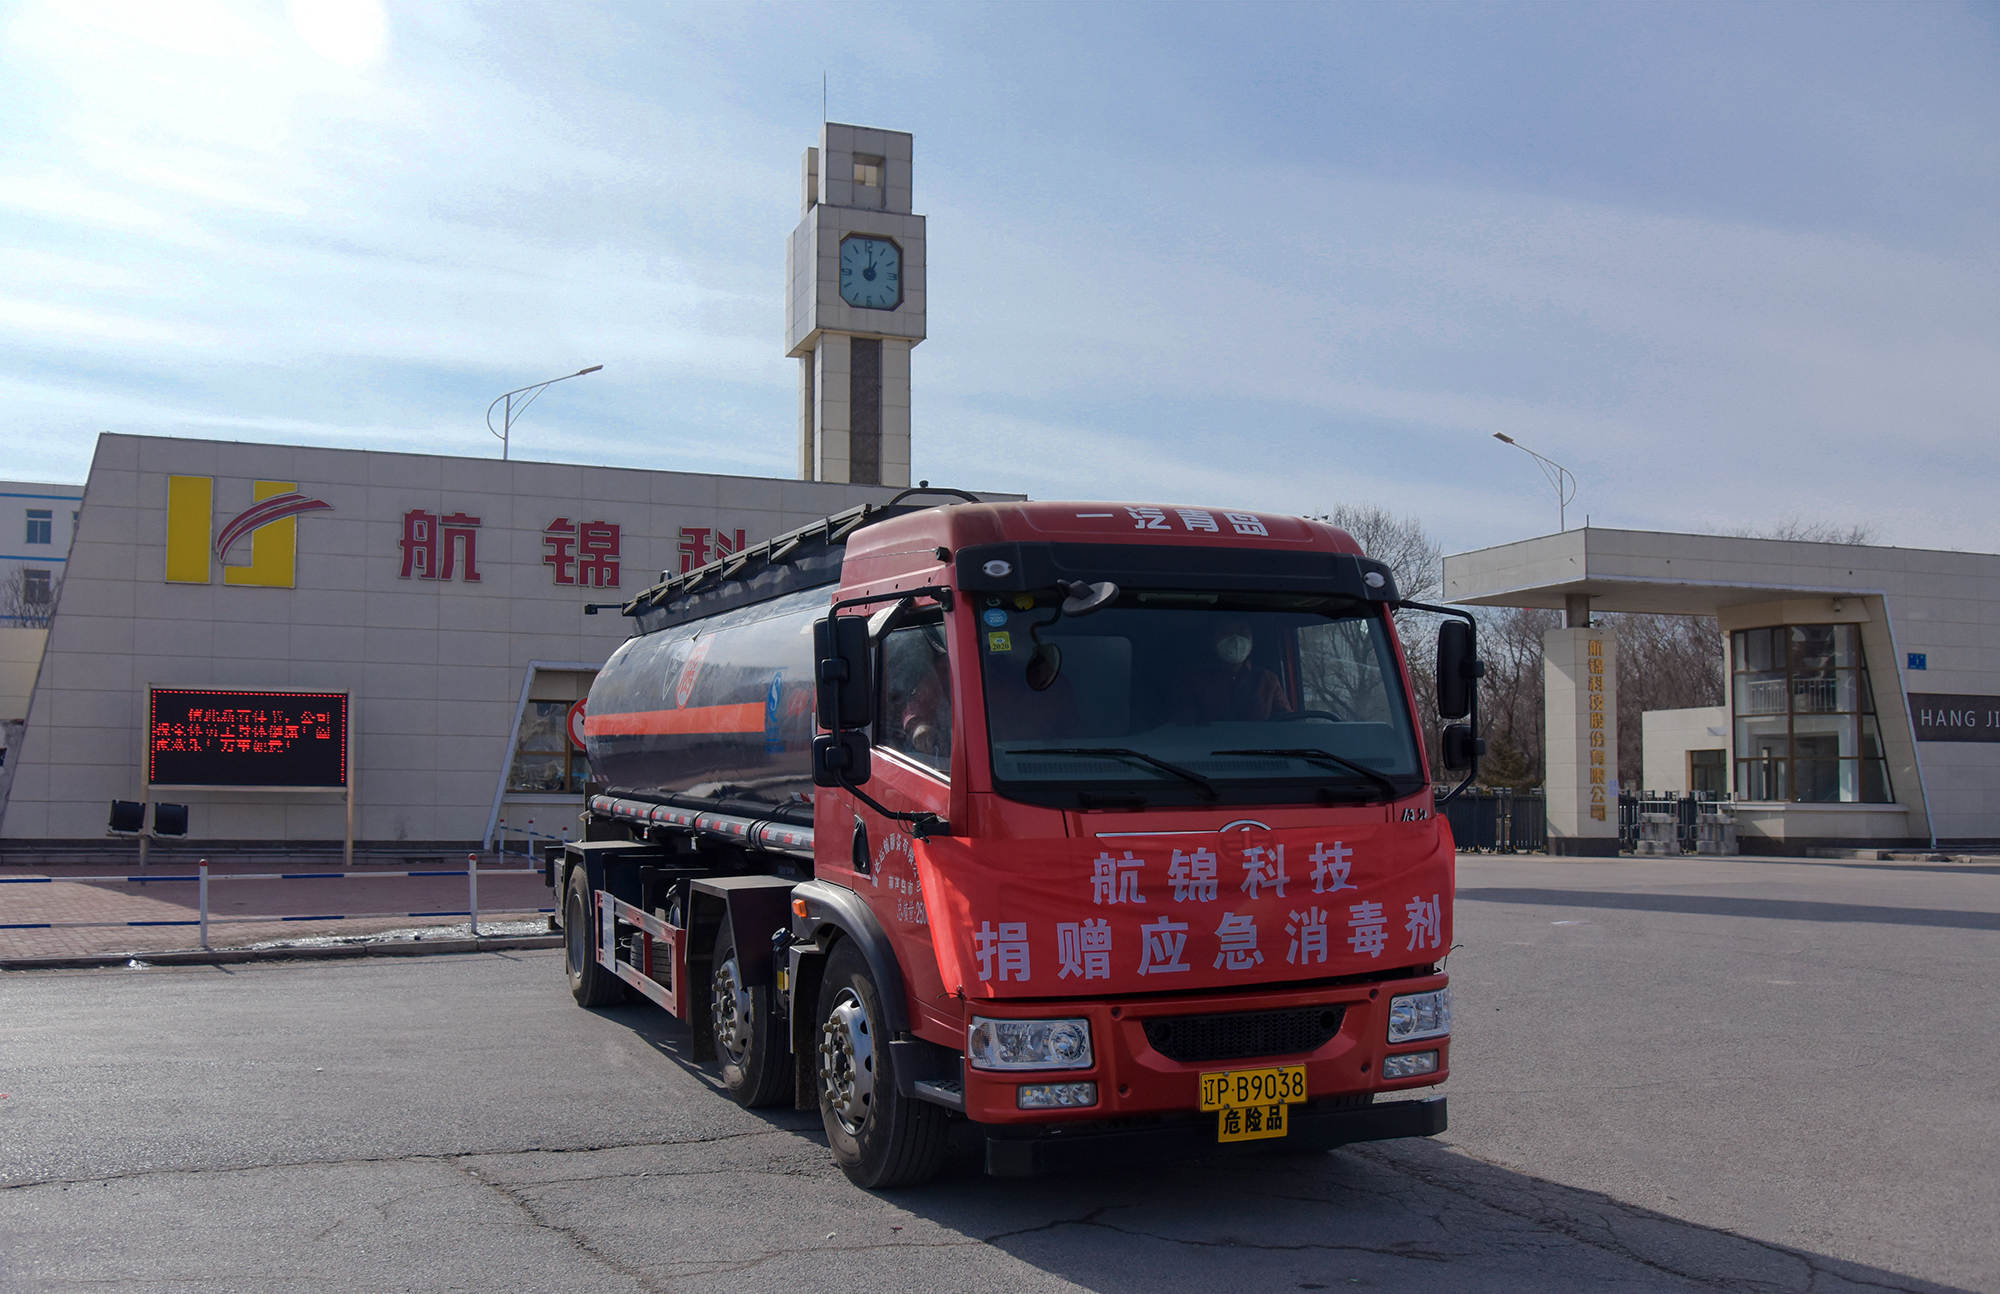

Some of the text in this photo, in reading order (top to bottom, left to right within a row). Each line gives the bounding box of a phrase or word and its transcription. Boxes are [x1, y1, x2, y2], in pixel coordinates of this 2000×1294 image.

[1076, 506, 1269, 536] 一汽青岛
[1588, 639, 1607, 822] 航锦科技股份有限公司
[1920, 708, 1976, 727] HANG
[1090, 841, 1357, 905] 航锦科技
[975, 894, 1441, 982] 捐赠应急消毒剂
[1223, 1105, 1282, 1134] 危险品
